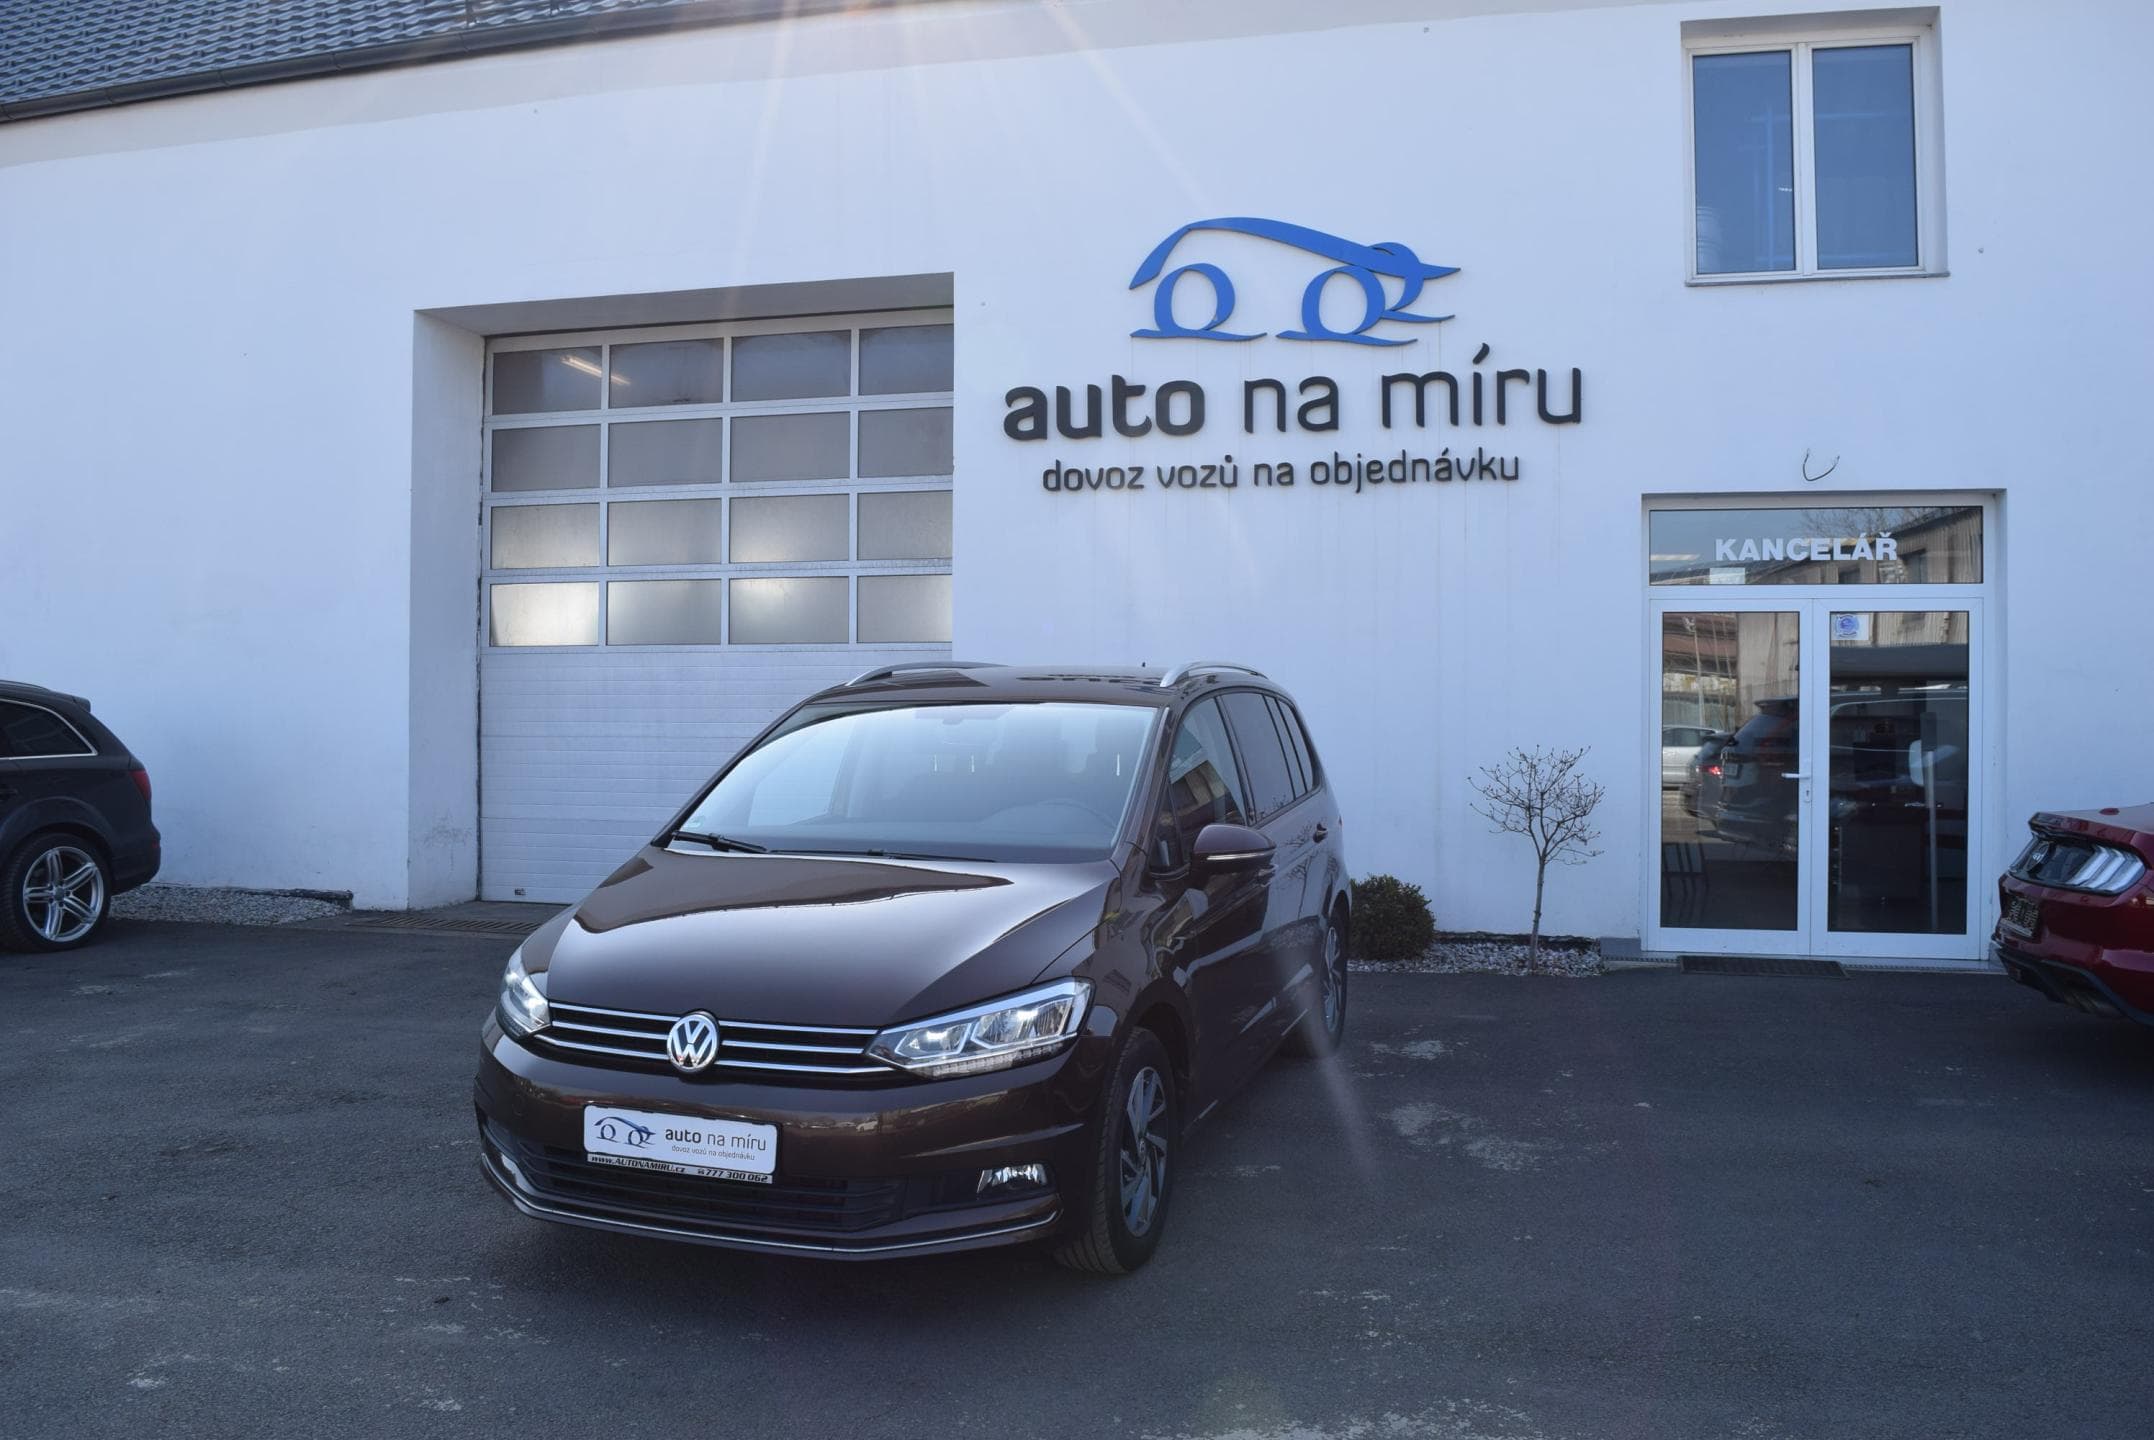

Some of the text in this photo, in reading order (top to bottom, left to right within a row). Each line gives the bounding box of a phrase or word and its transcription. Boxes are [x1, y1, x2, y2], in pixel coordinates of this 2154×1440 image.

[1002, 342, 1583, 441] auto na míru
[1042, 446, 1520, 494] dovoz vozů na objednávku
[1714, 531, 1898, 561] KANCELÁŘ
[665, 1128, 767, 1151] auto na míru
[706, 1168, 725, 1179] 777
[727, 1171, 746, 1180] 300
[747, 1173, 769, 1182] 062
